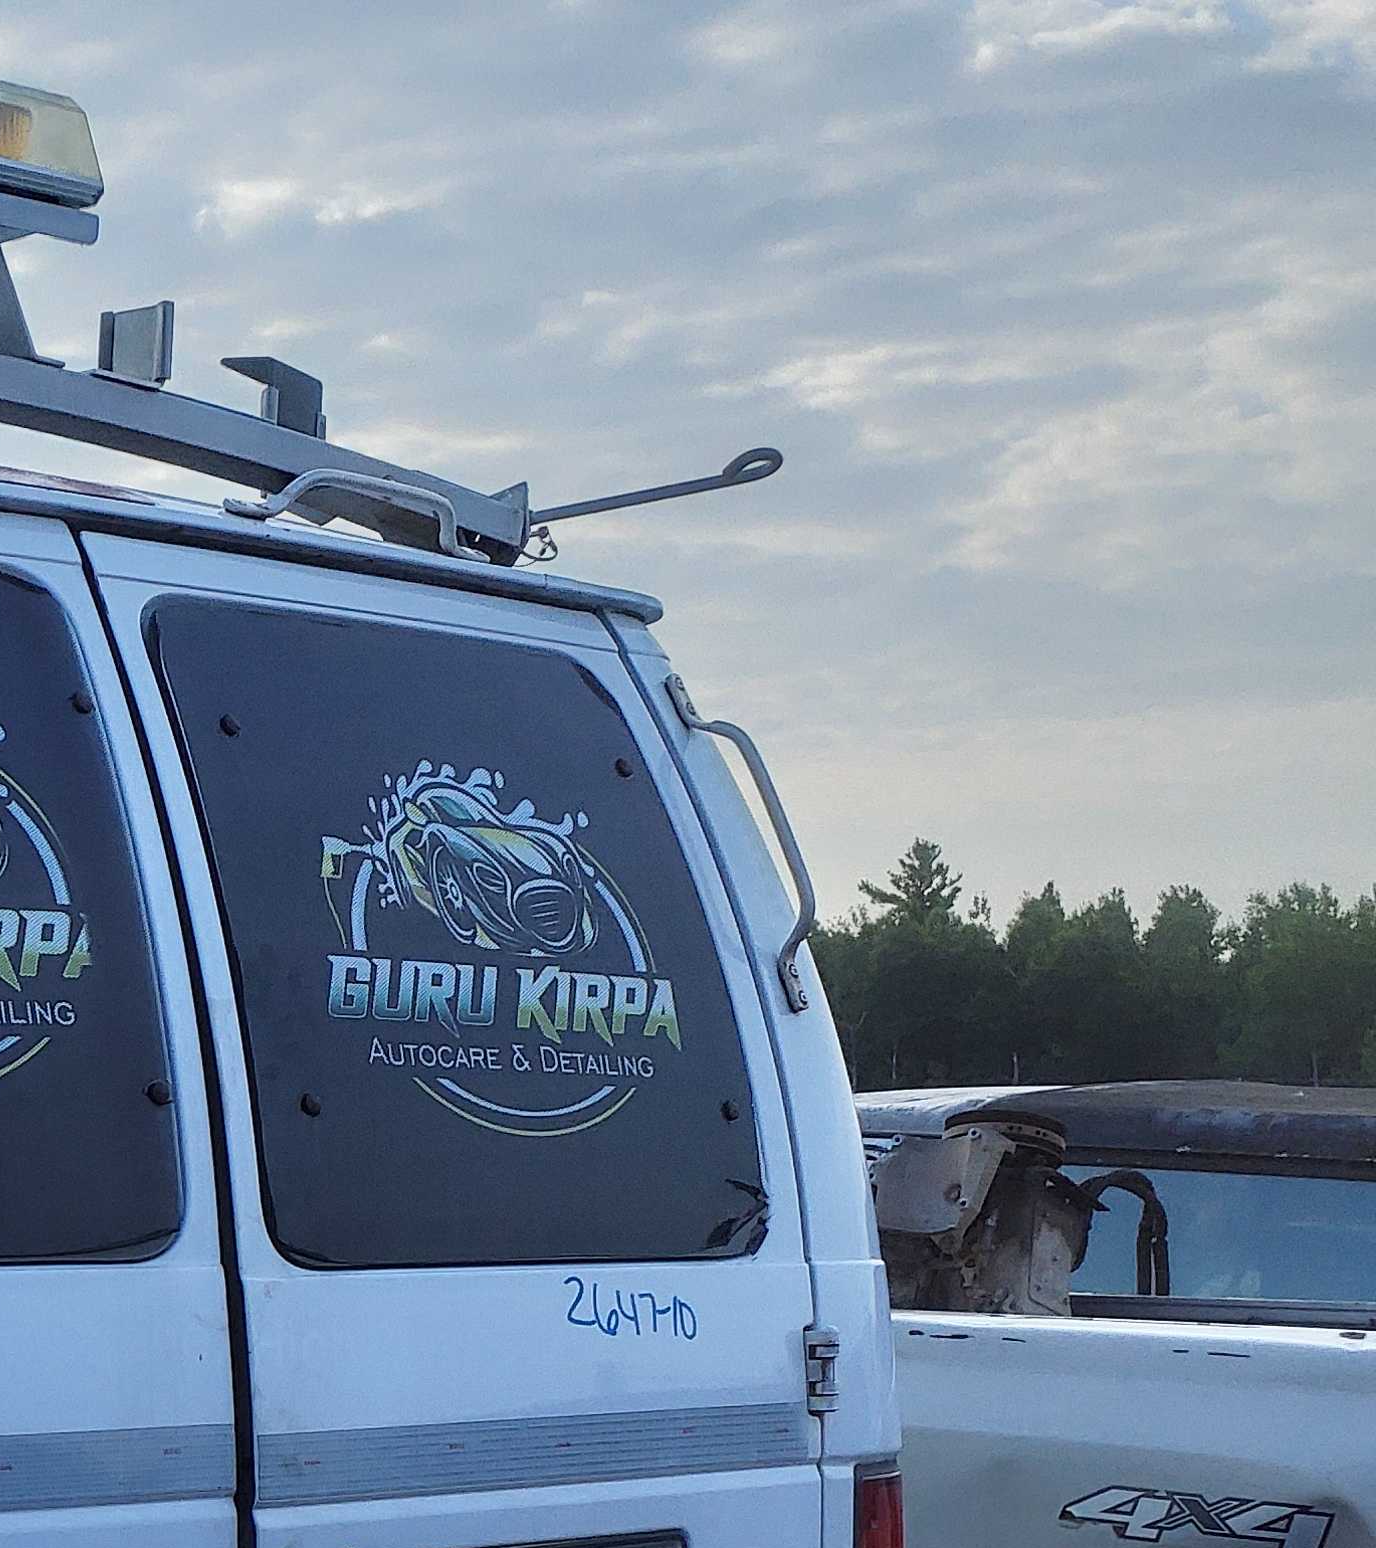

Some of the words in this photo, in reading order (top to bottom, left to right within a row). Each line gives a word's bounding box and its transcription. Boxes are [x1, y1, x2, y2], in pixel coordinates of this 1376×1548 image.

[325, 953, 496, 1038] GURU
[515, 964, 683, 1051] KIRPA
[511, 1043, 532, 1072] &
